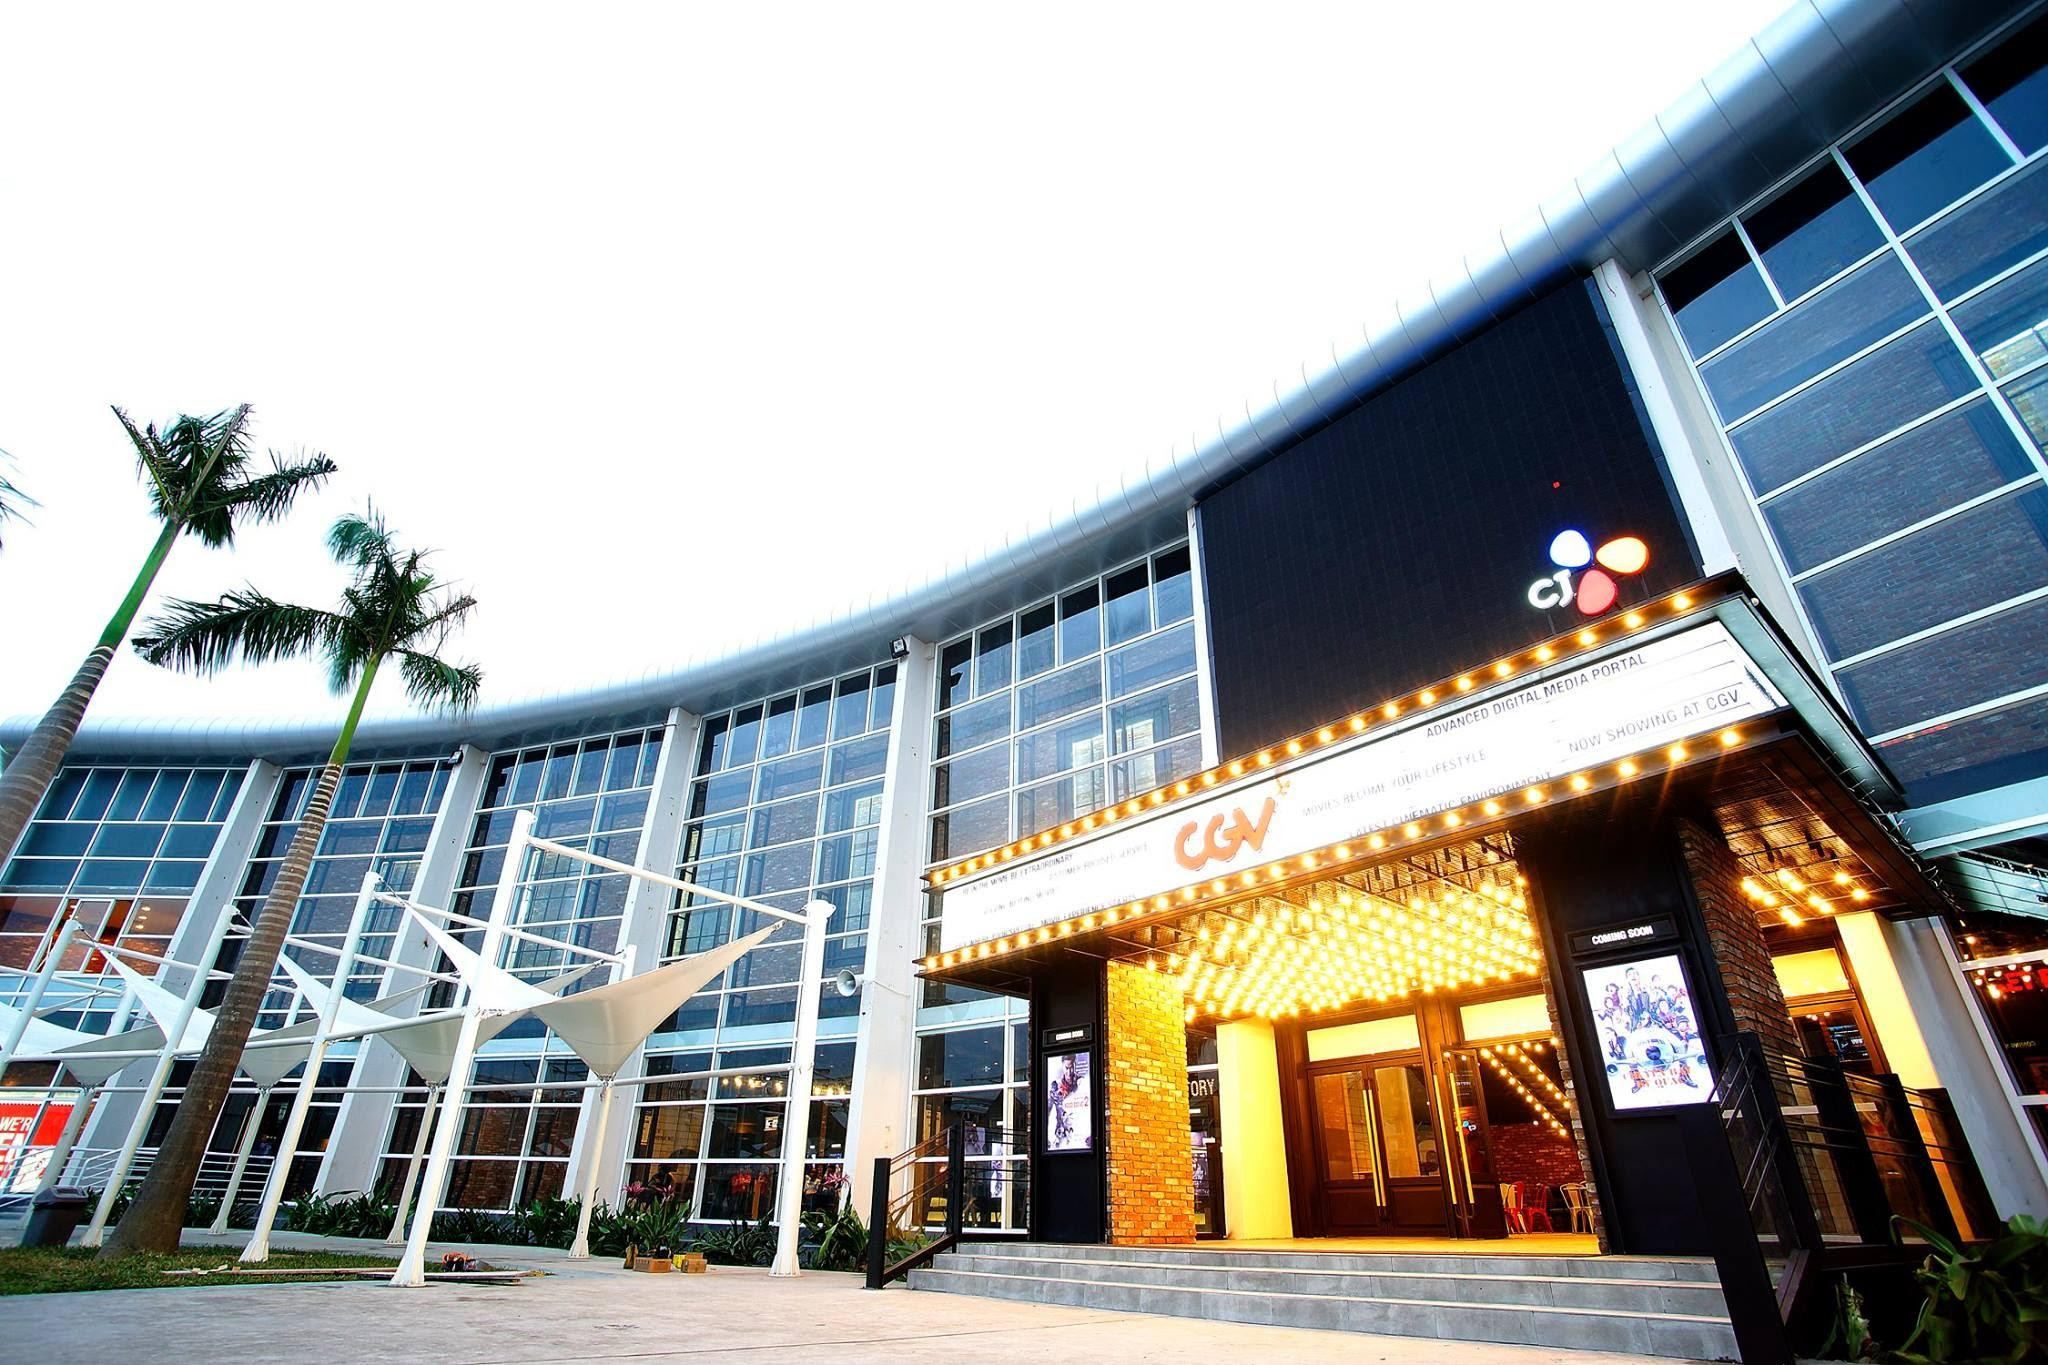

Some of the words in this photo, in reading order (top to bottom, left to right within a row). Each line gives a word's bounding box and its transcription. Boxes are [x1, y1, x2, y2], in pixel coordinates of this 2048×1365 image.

[1528, 569, 1574, 609] CJ
[1426, 707, 1489, 738] ADVANCED
[1493, 689, 1542, 716] DIGITAL
[1543, 673, 1590, 699] MEDIA
[1591, 653, 1648, 681] PORTAL
[1568, 733, 1601, 753] NOW
[1605, 709, 1678, 742] SHOWING
[1683, 701, 1701, 718] AT
[1706, 689, 1740, 711] CGV
[1391, 769, 1422, 788] YOUR
[1425, 748, 1487, 779] LIFESTYLE
[1174, 797, 1276, 870] CGV
[1591, 930, 1627, 945] COMING
[1627, 925, 1654, 938] SOON
[1188, 1079, 1215, 1096] ORY
